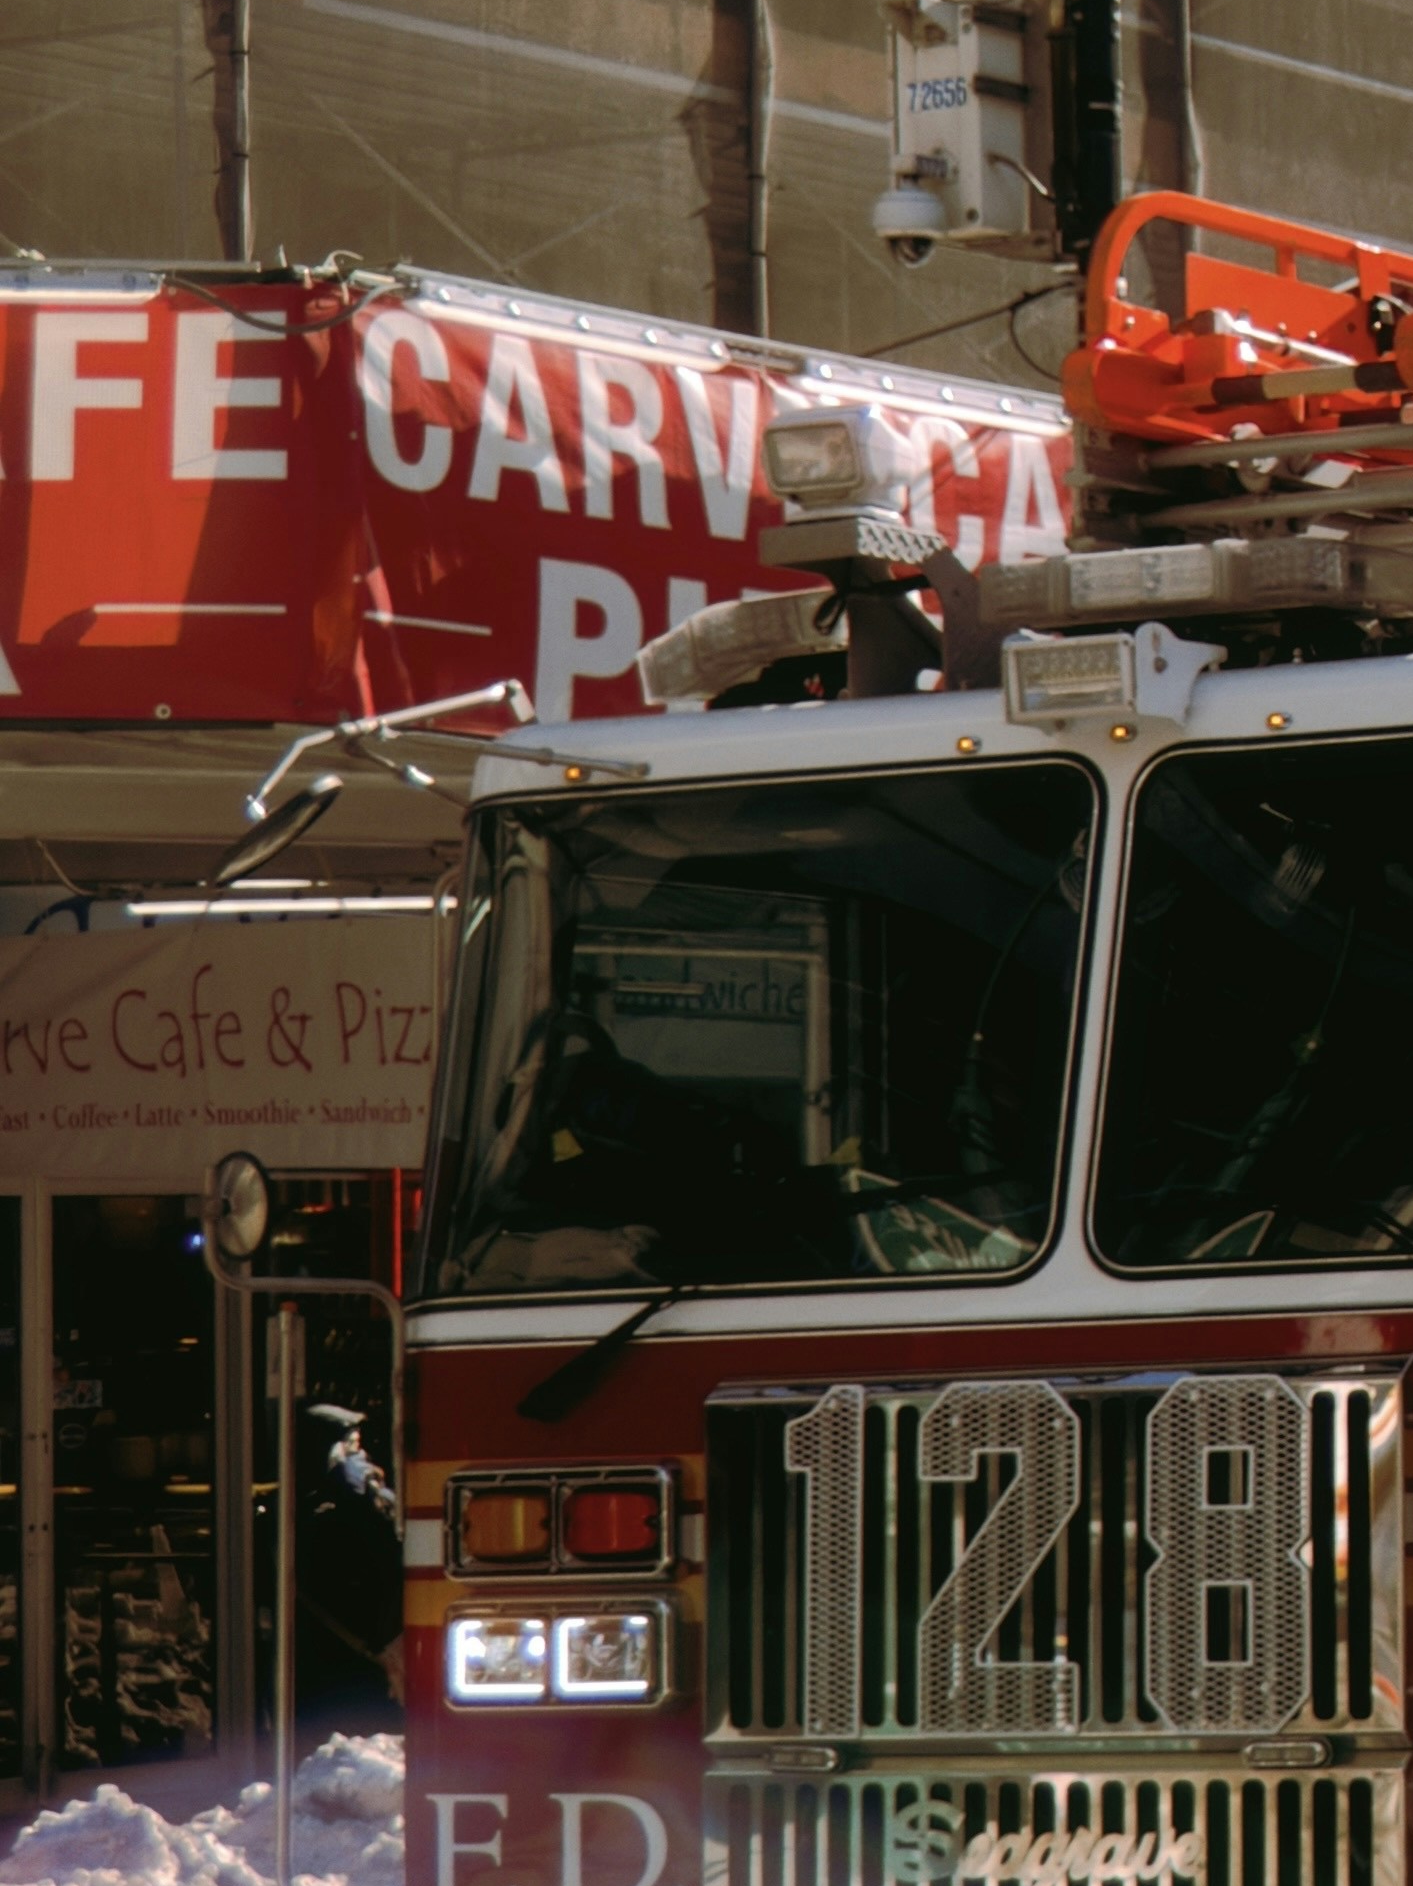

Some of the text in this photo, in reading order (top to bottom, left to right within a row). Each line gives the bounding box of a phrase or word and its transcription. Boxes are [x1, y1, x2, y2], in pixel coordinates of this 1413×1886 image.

[907, 76, 967, 111] 72656
[0, 310, 288, 480] FE
[356, 310, 808, 540] CARV
[111, 964, 246, 1079] Cafe
[267, 985, 313, 1073] &
[0, 1096, 412, 1131] ast Coffee Latte Smoothie Sandwich
[784, 1374, 1311, 1738] 128
